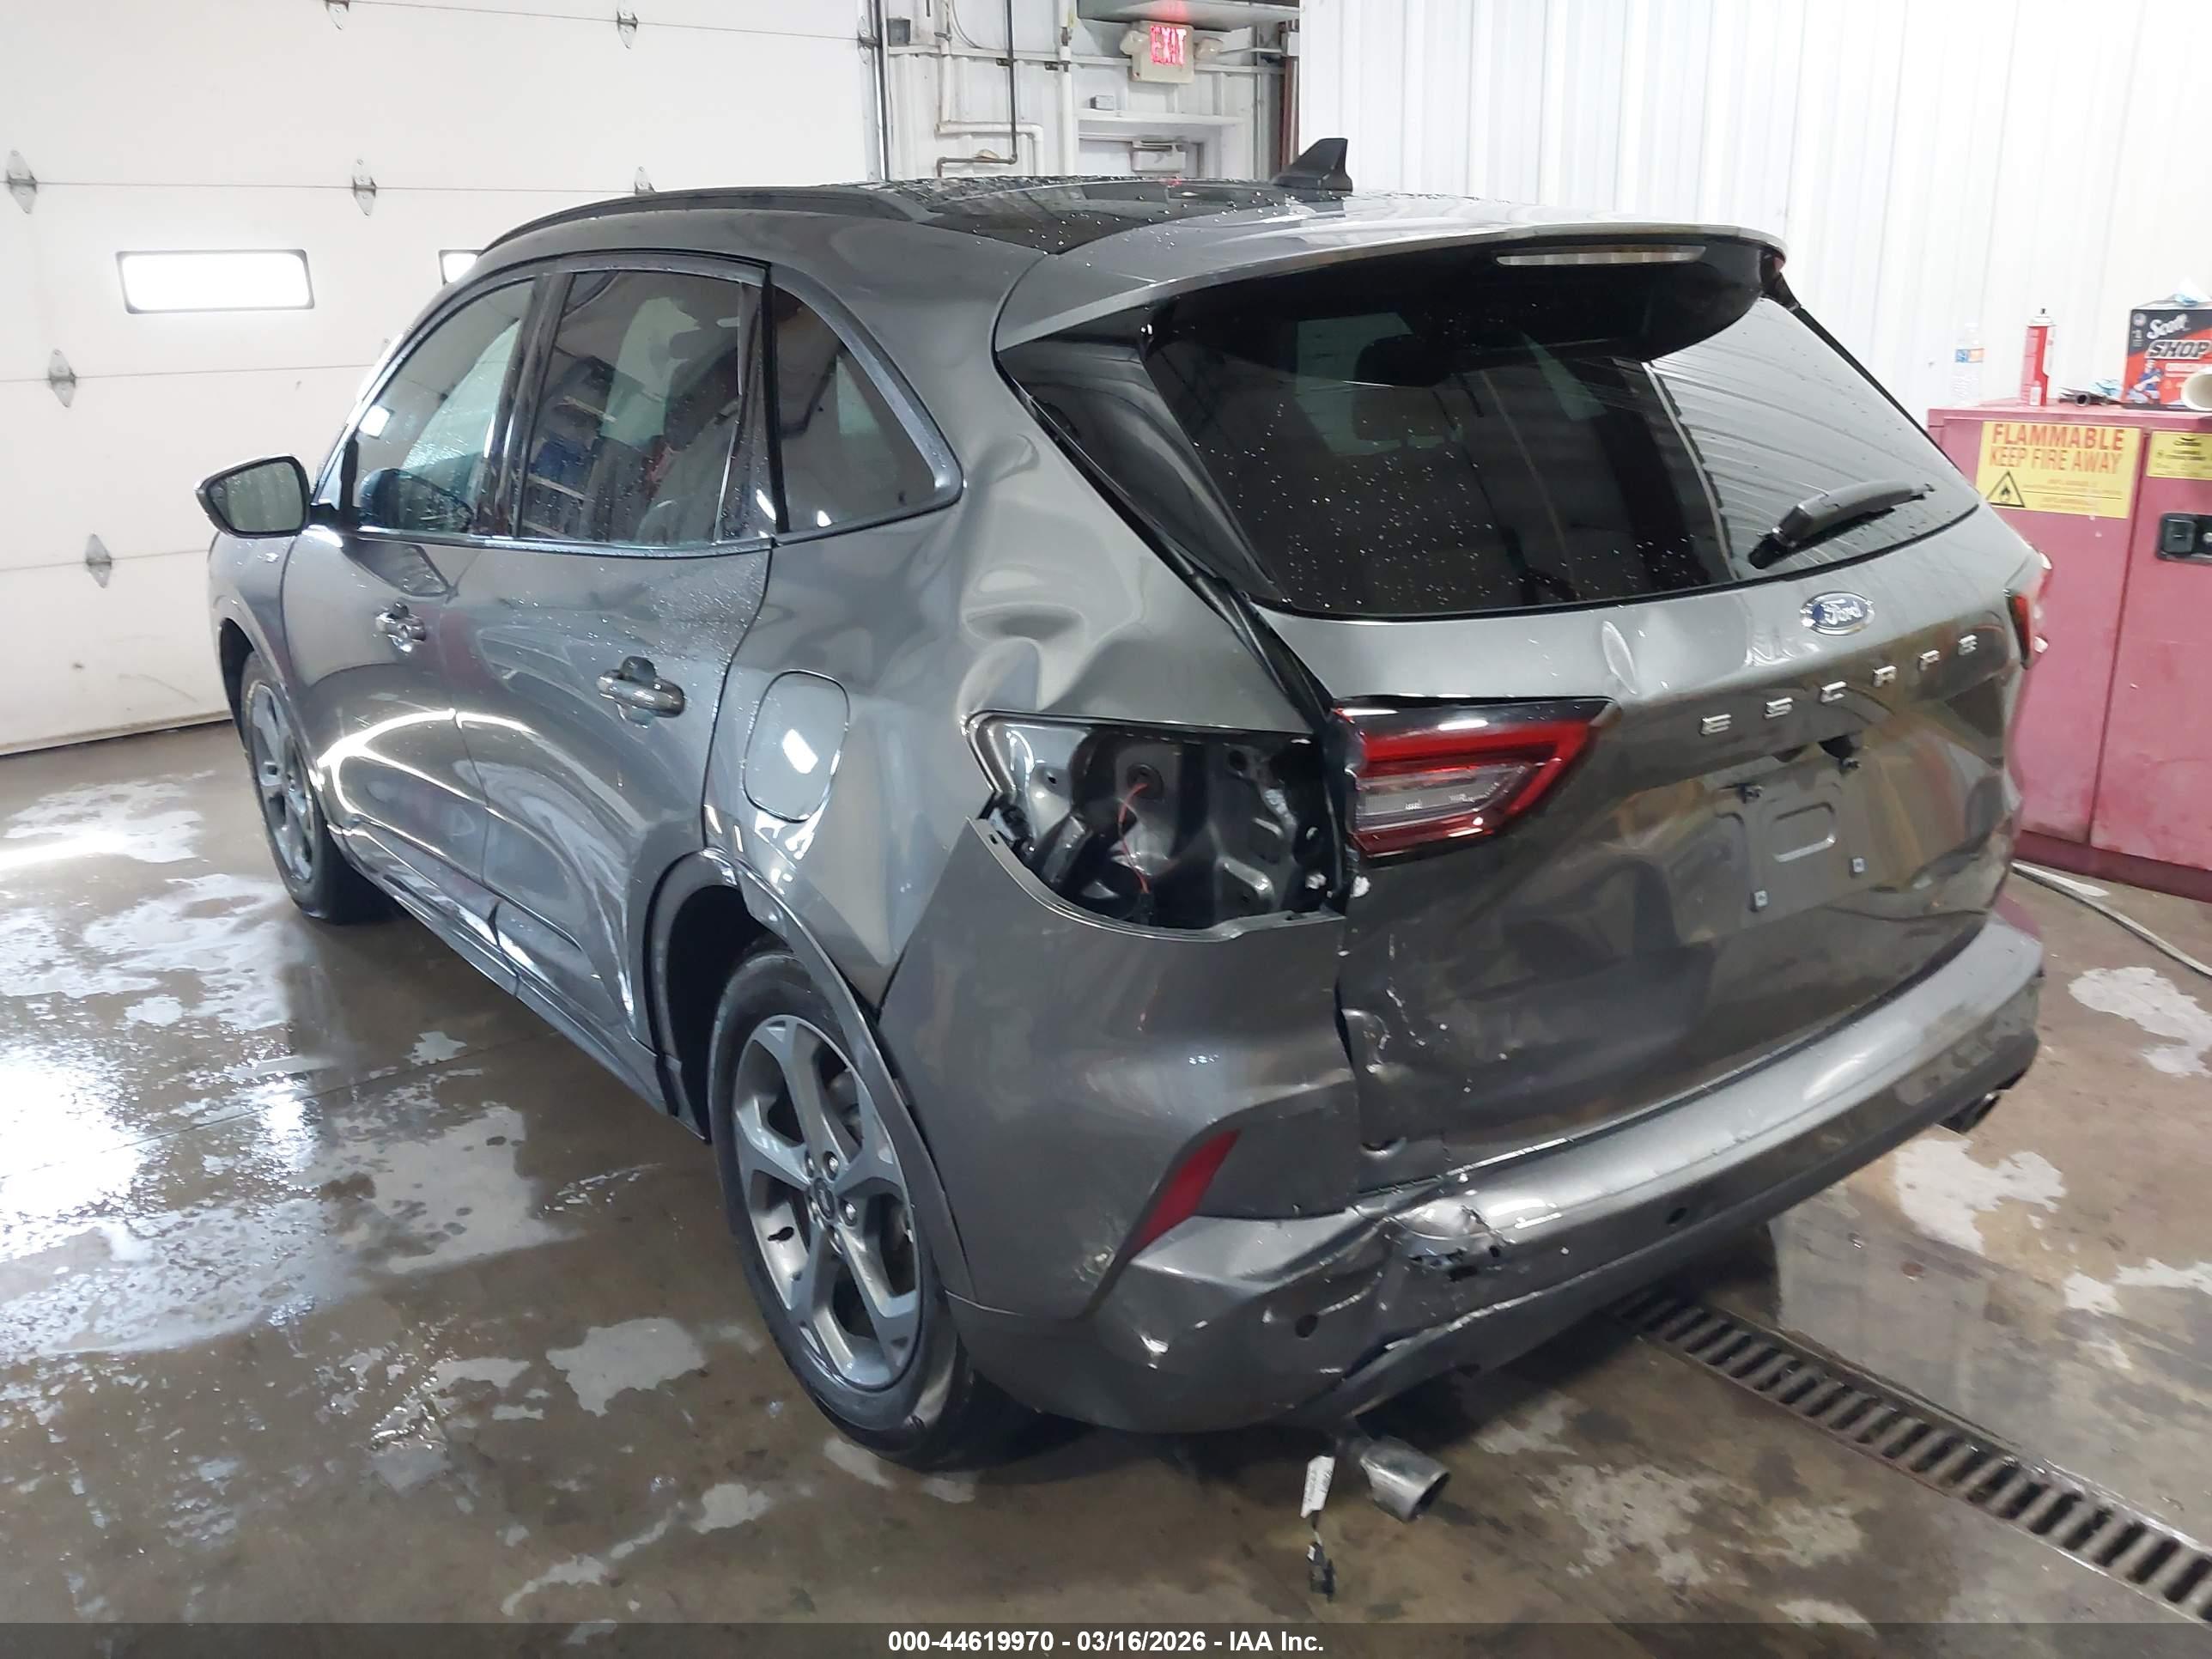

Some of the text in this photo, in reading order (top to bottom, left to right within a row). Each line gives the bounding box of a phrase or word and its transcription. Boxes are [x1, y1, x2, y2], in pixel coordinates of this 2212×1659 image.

[1151, 26, 1187, 65] EXIT
[2147, 313, 2190, 339] Scott
[2147, 341, 2210, 358] SHOP
[1992, 423, 2124, 451] FLAMMABLE
[1990, 446, 2123, 474] KEEP FIRE AWAY
[1821, 598, 1864, 625] Ford
[1700, 634, 1978, 736] ESCAPE
